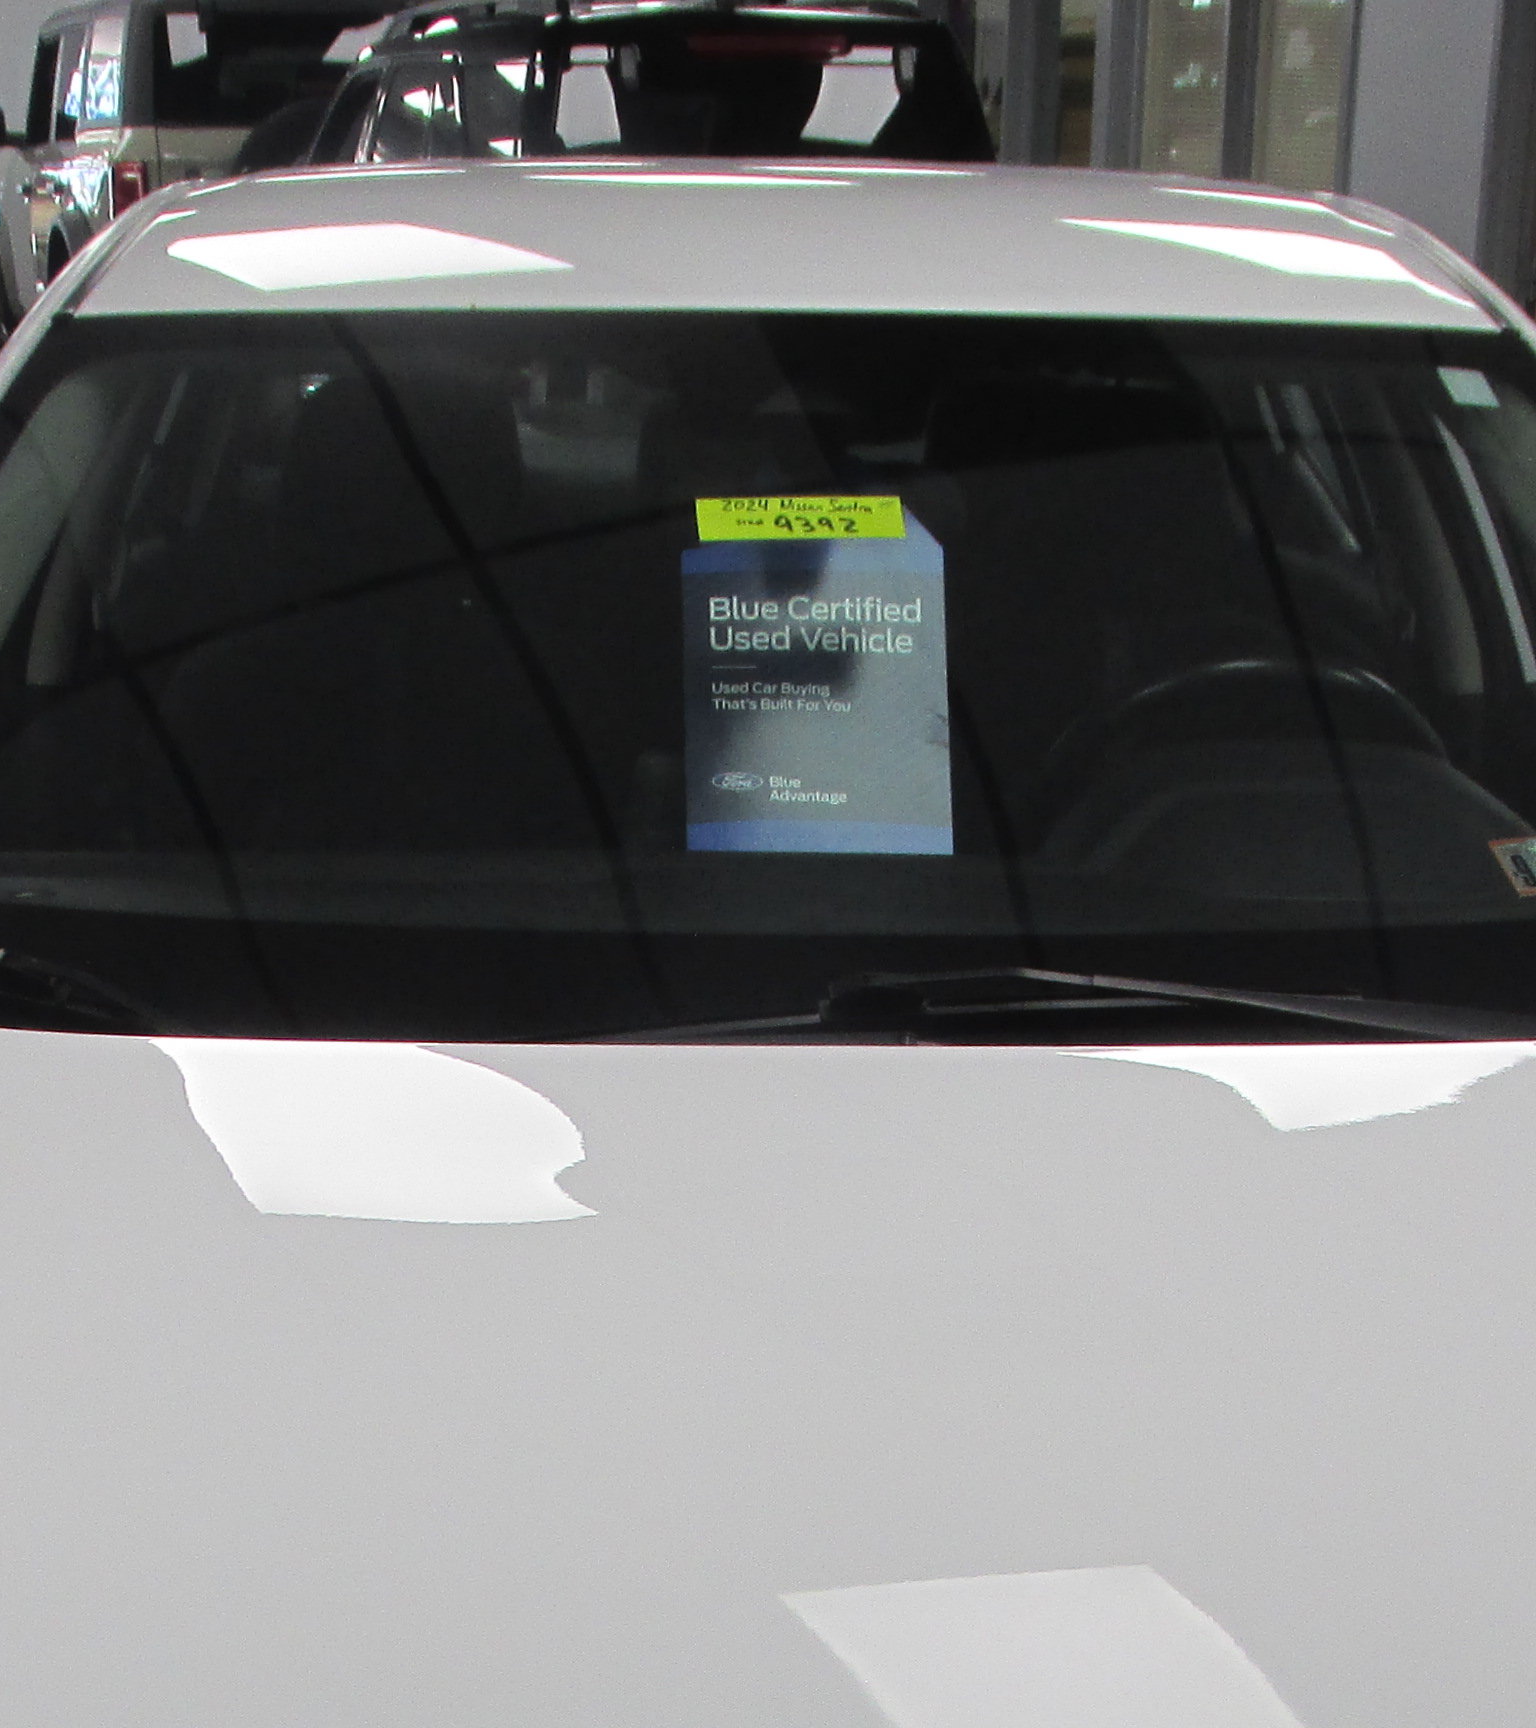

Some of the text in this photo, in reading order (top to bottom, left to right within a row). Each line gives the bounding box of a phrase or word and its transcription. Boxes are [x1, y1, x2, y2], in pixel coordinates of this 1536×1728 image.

[722, 499, 768, 511] 2024
[774, 515, 858, 533] 9392
[709, 596, 922, 623] Blue Certified
[709, 625, 913, 653] Used Vehicle
[712, 682, 830, 698] Used Car Buying
[713, 699, 852, 713] That's Built For You
[769, 776, 801, 788] Blue
[769, 790, 848, 805] Advantage
